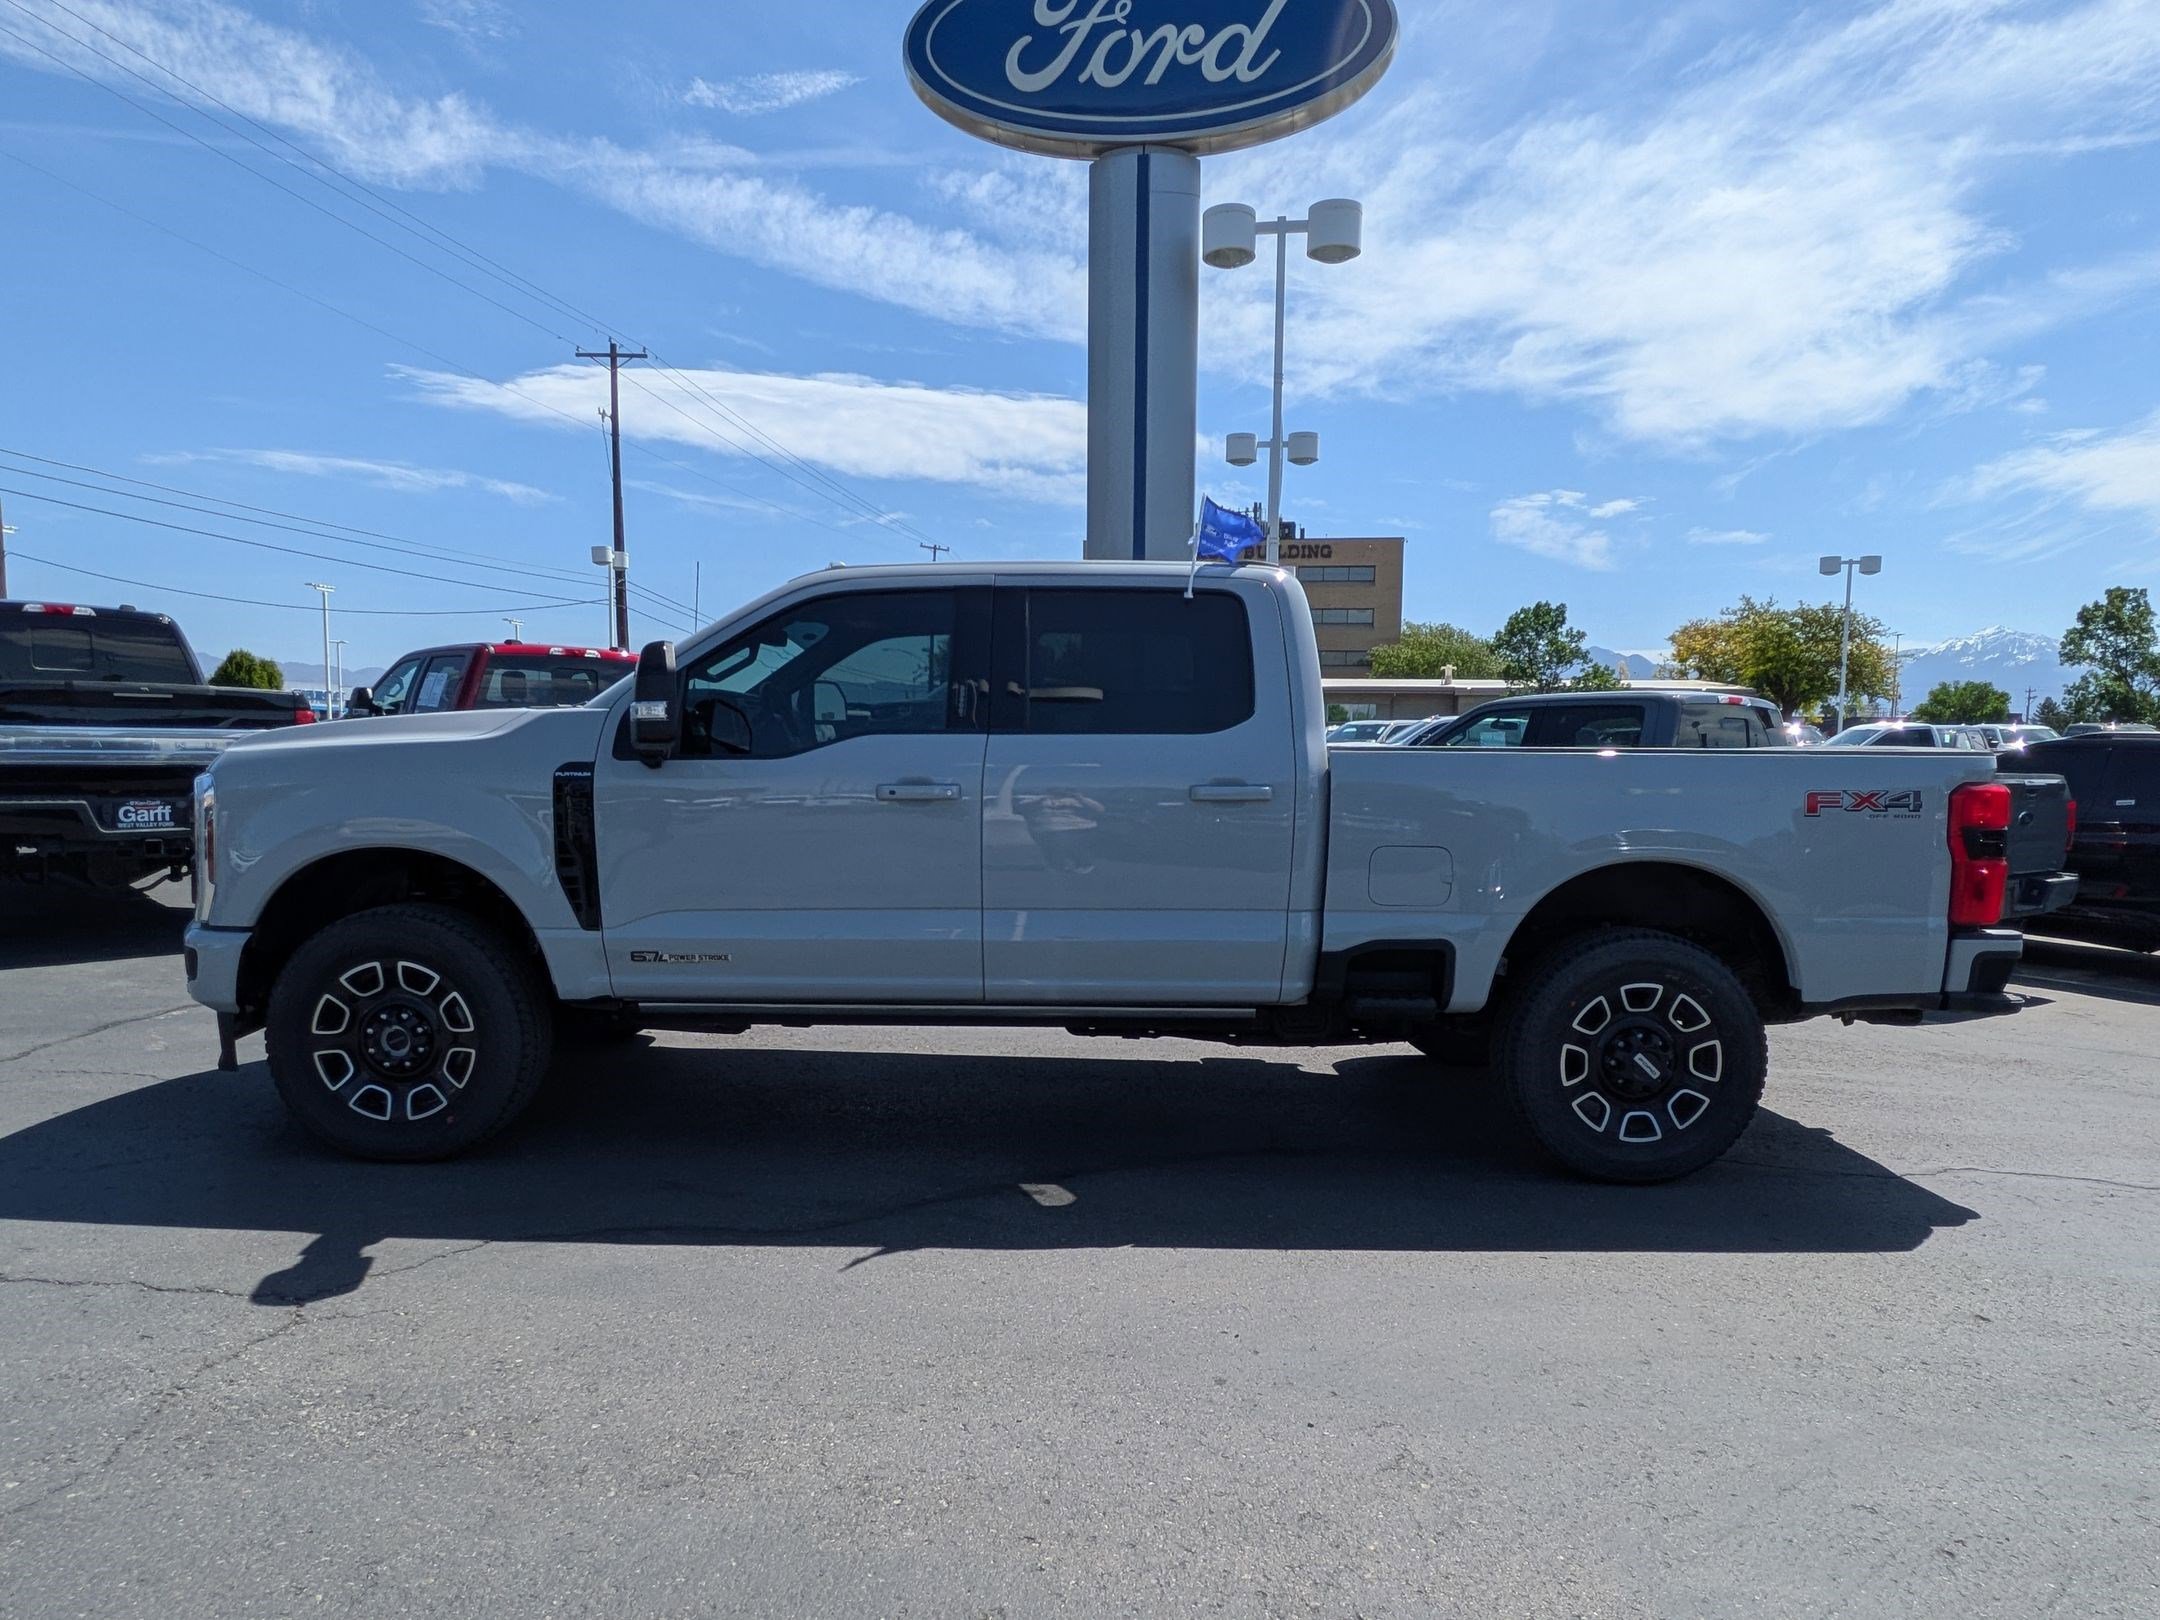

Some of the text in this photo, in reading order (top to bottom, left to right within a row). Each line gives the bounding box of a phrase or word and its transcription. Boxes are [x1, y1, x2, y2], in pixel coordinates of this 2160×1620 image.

[1005, 0, 1288, 92] Ford
[1243, 544, 1332, 559] BULDING
[1804, 790, 1923, 817] FX4
[118, 805, 172, 822] Garff
[669, 953, 697, 961] POWER
[698, 953, 730, 961] STROKE
